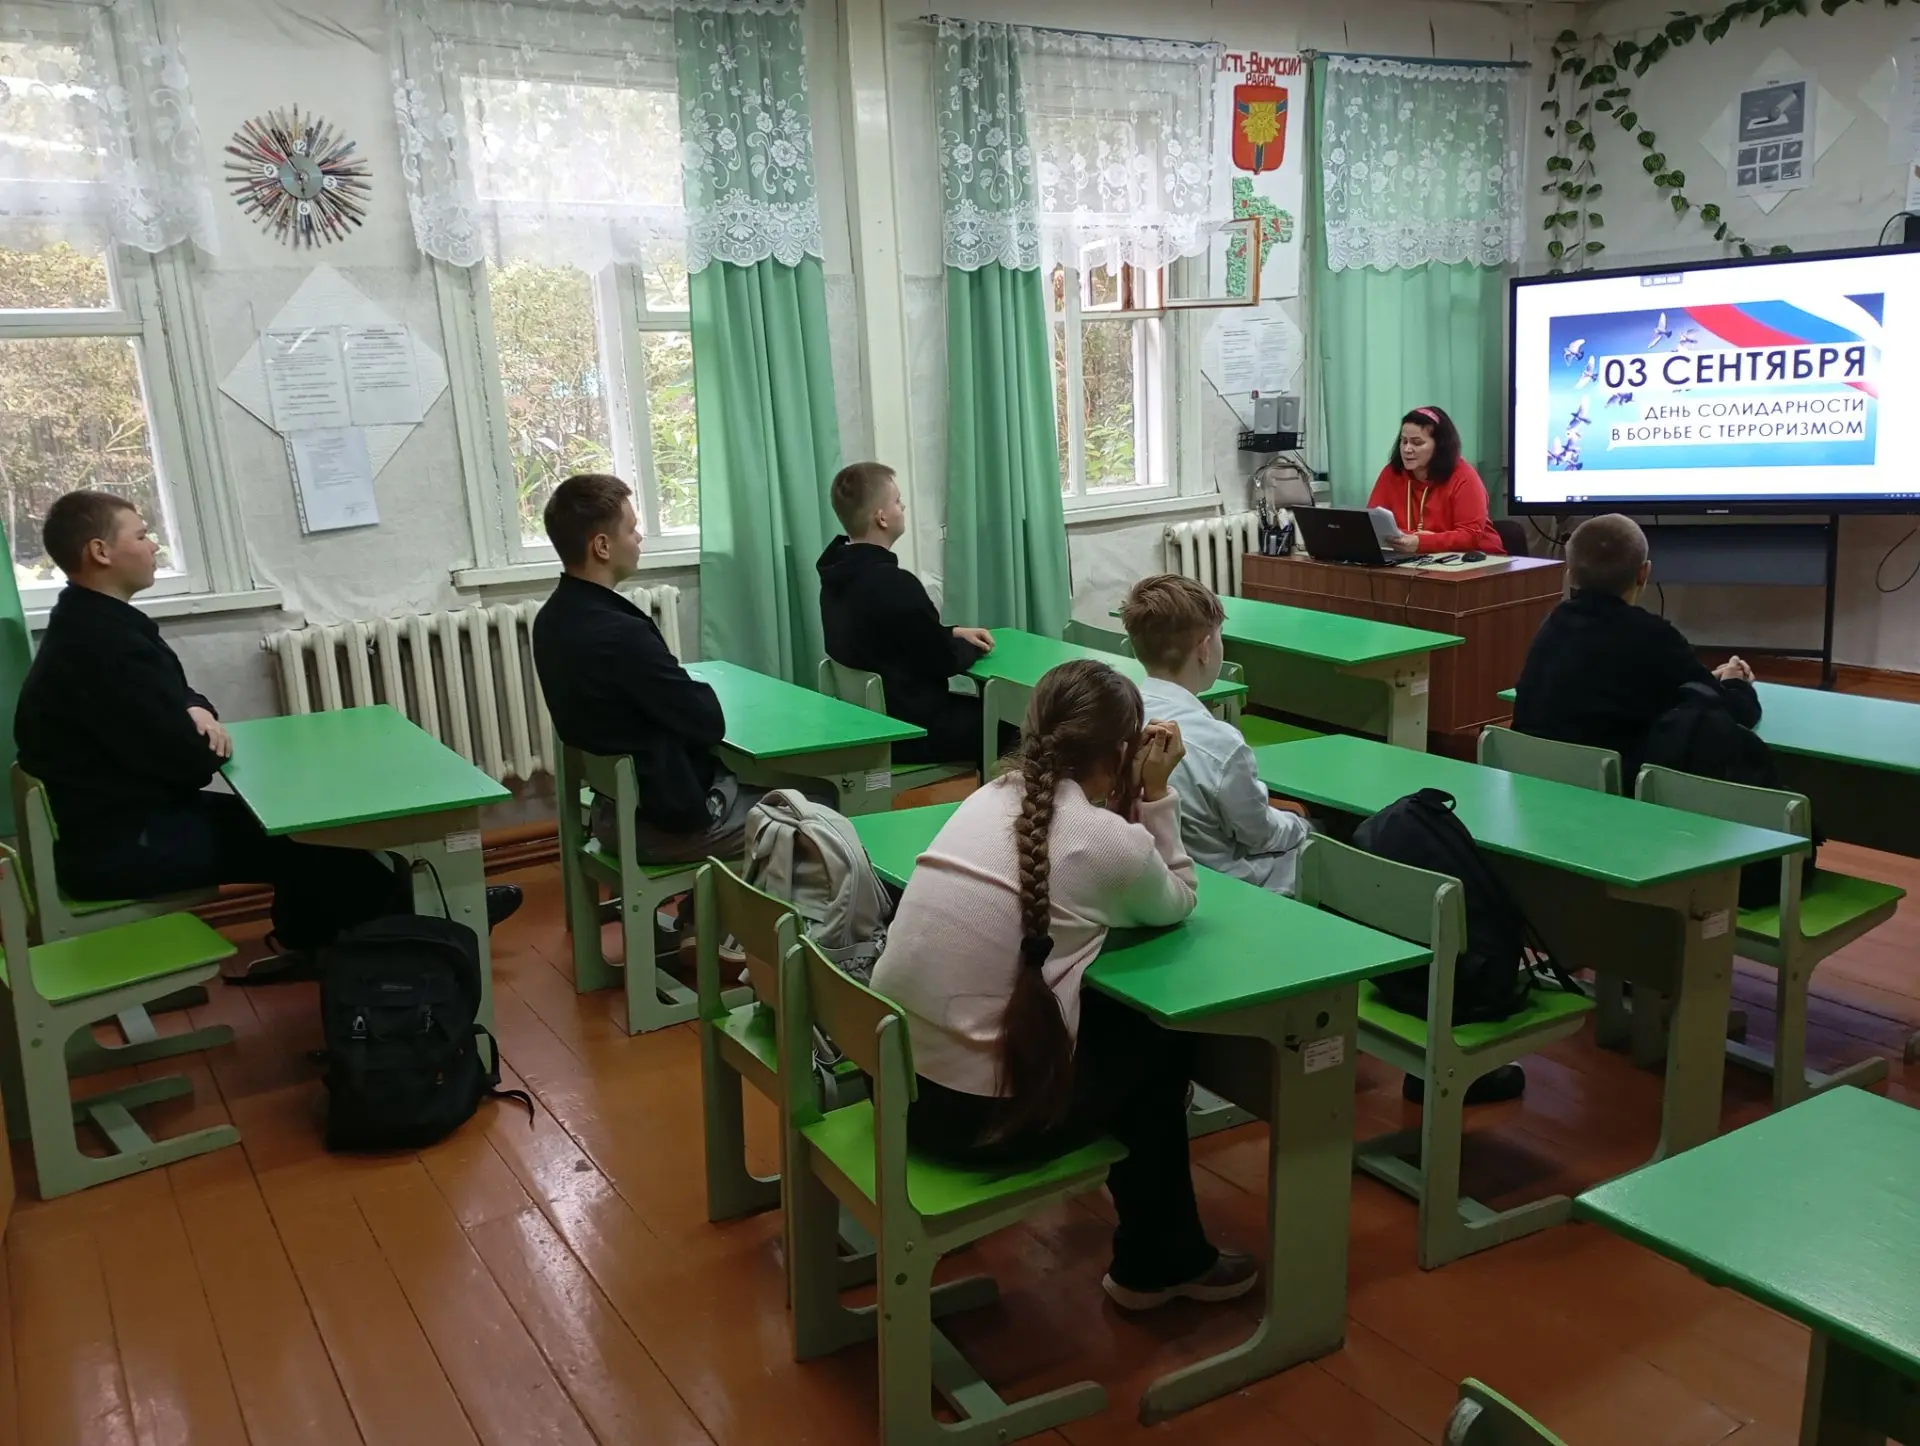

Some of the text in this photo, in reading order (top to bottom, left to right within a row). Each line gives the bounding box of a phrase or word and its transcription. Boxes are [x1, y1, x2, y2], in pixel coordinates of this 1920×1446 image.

[1605, 346, 1865, 388] 03 СЕНТЯБРЯ
[1644, 398, 1864, 420] ДЕНЬ СОЛИДАРНОСТИ
[1611, 421, 1863, 441] В БОРЬБЕ С ТЕРРОРИЗМОМ
